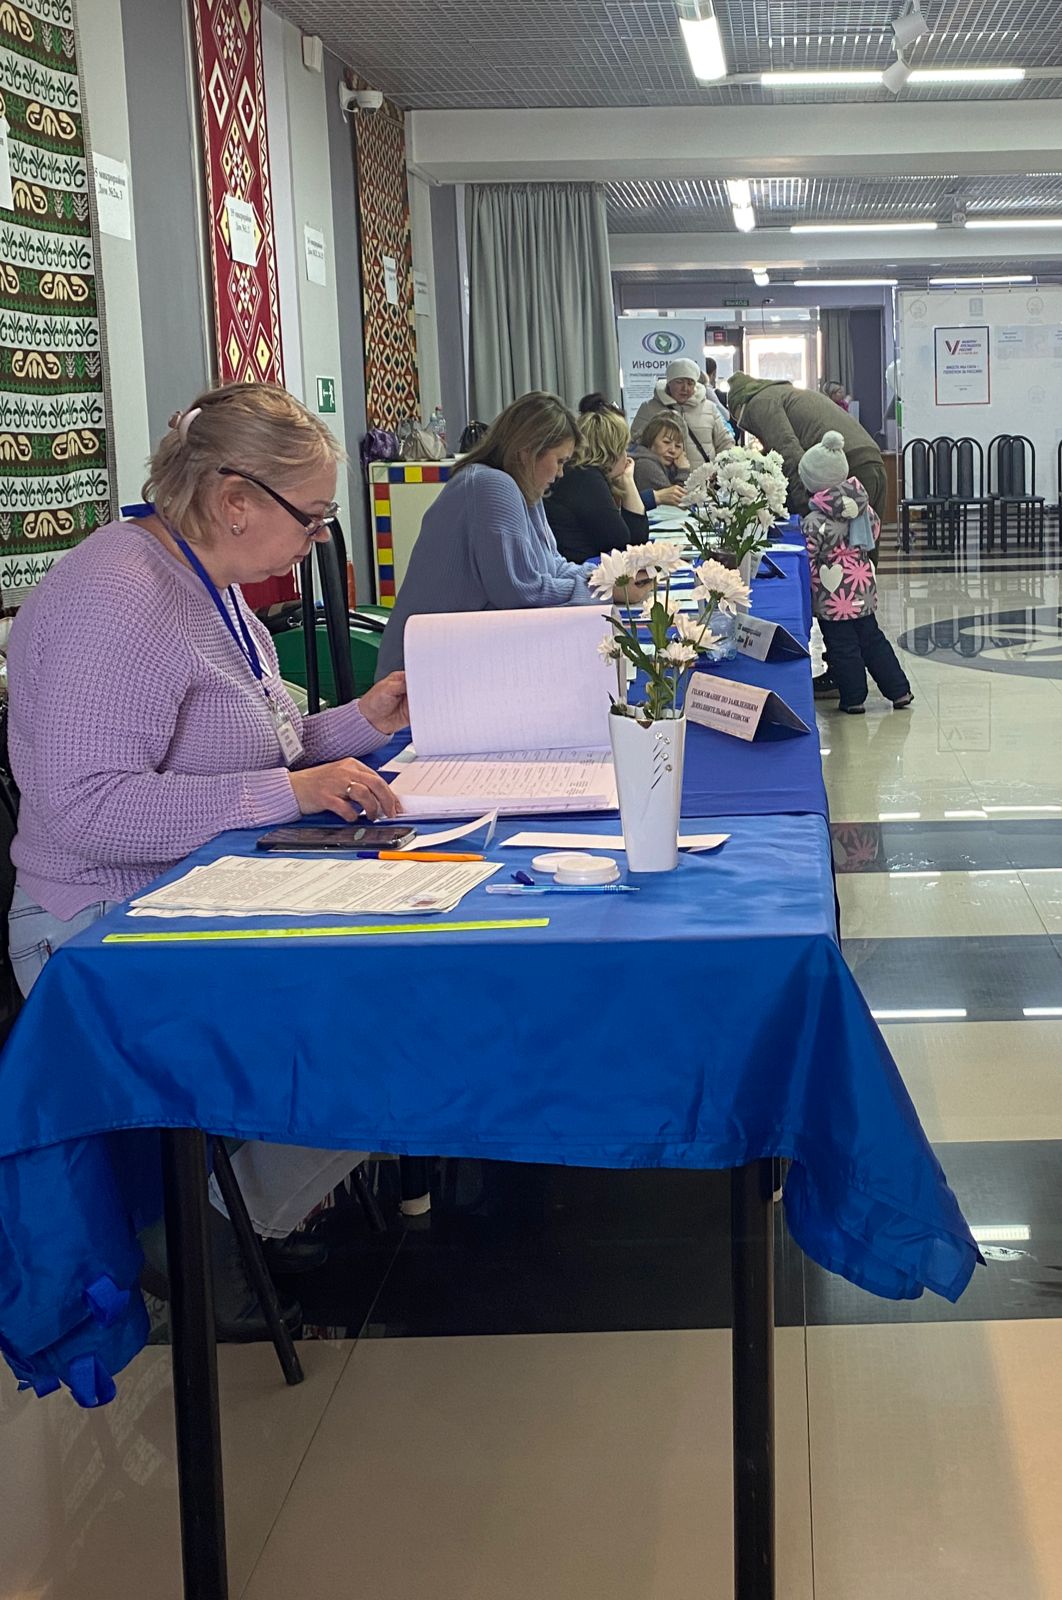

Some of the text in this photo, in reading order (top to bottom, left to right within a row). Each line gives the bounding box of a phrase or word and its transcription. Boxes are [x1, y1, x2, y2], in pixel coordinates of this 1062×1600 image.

[691, 688, 758, 712] ГОЛОСОВАНИЕ ПО ЗАЯВЛЕНИЯМ
[691, 701, 750, 723] ДОПОЛНИТЕЛЬНЫЙ СПИСОК
